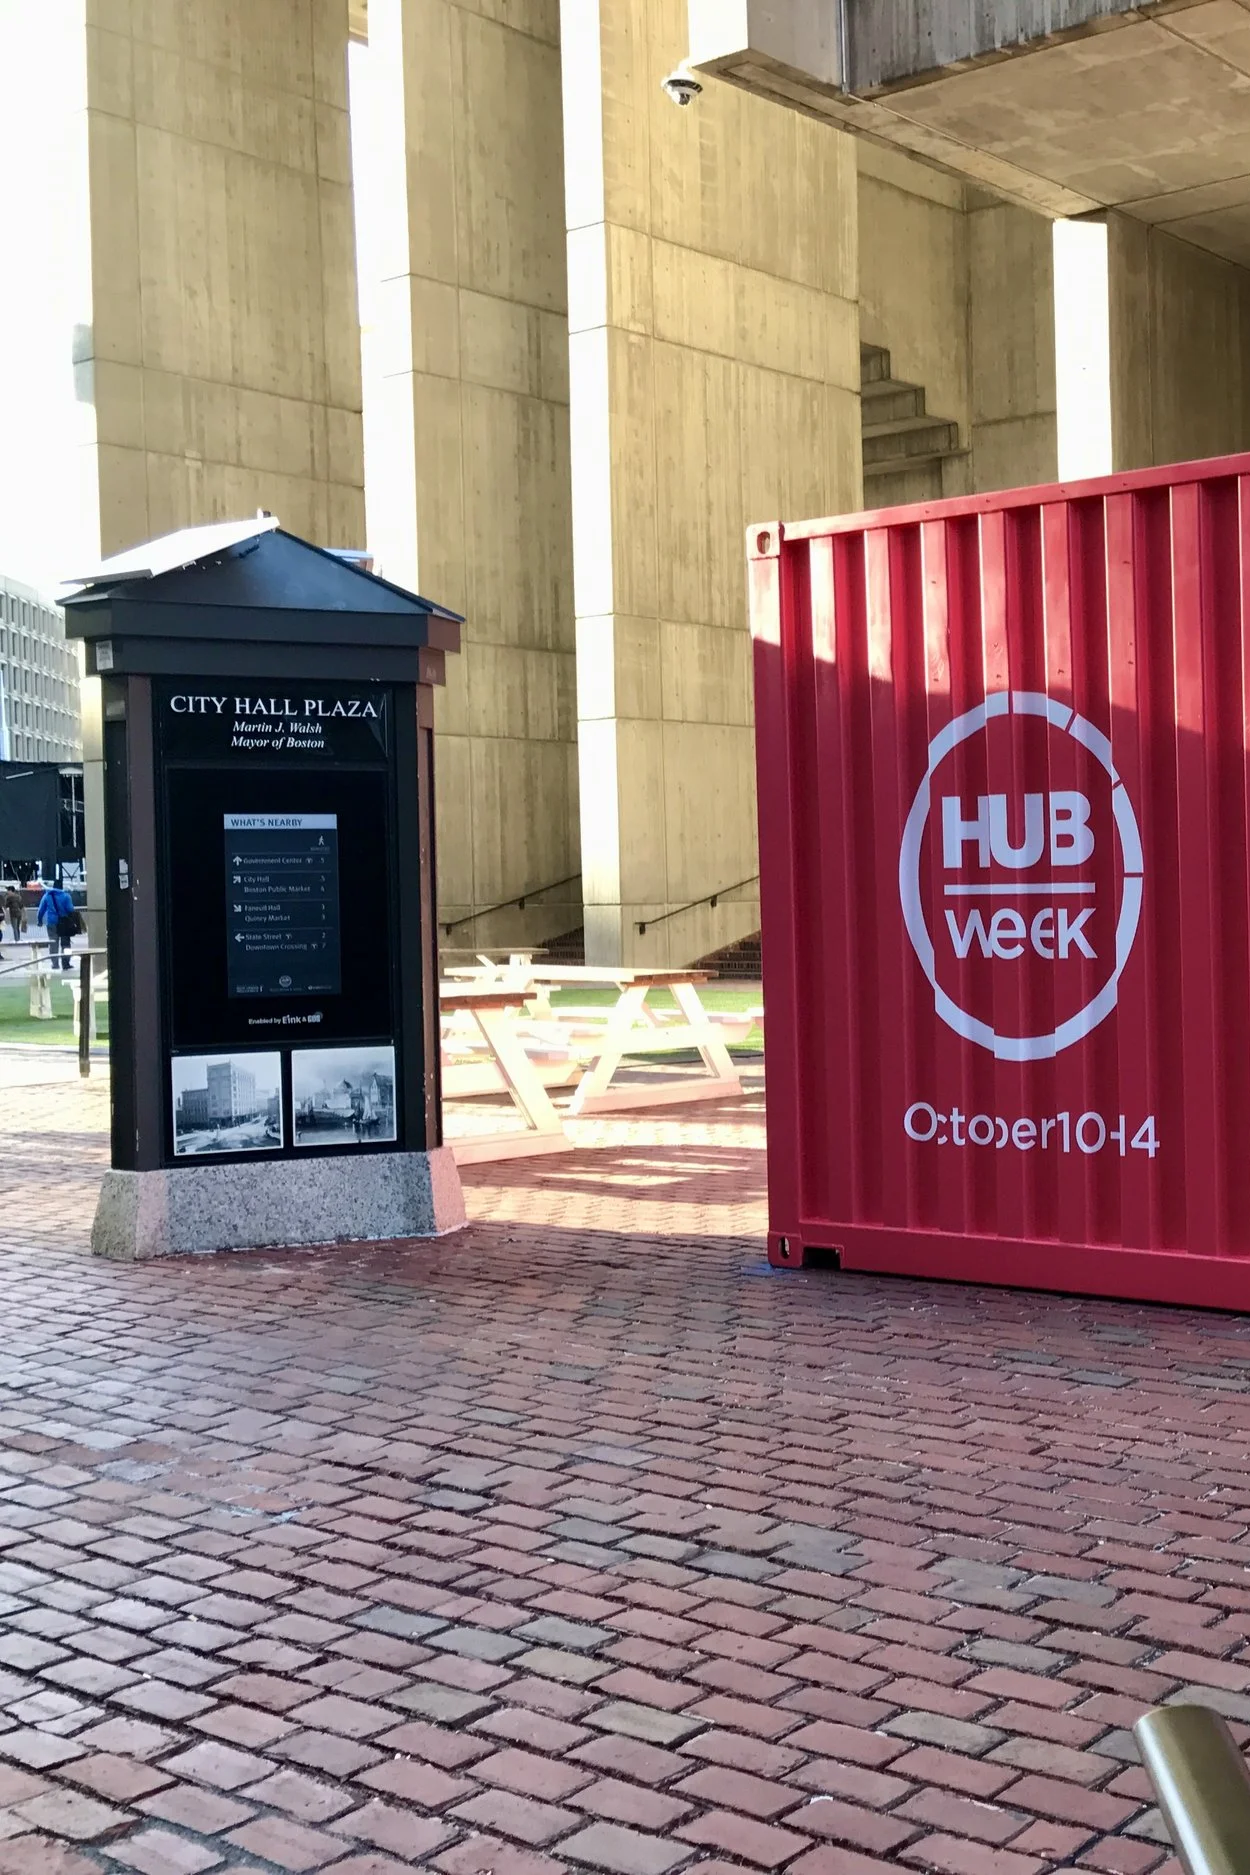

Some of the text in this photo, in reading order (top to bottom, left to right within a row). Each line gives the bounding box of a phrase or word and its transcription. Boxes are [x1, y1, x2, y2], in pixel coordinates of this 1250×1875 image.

[170, 695, 378, 718] CITY HALL PLAZA
[233, 721, 322, 734] Martin J. Walsh
[231, 736, 325, 749] Mayor of Boston
[231, 818, 302, 827] WHAT'S NEARBY
[942, 791, 1095, 869] HUB
